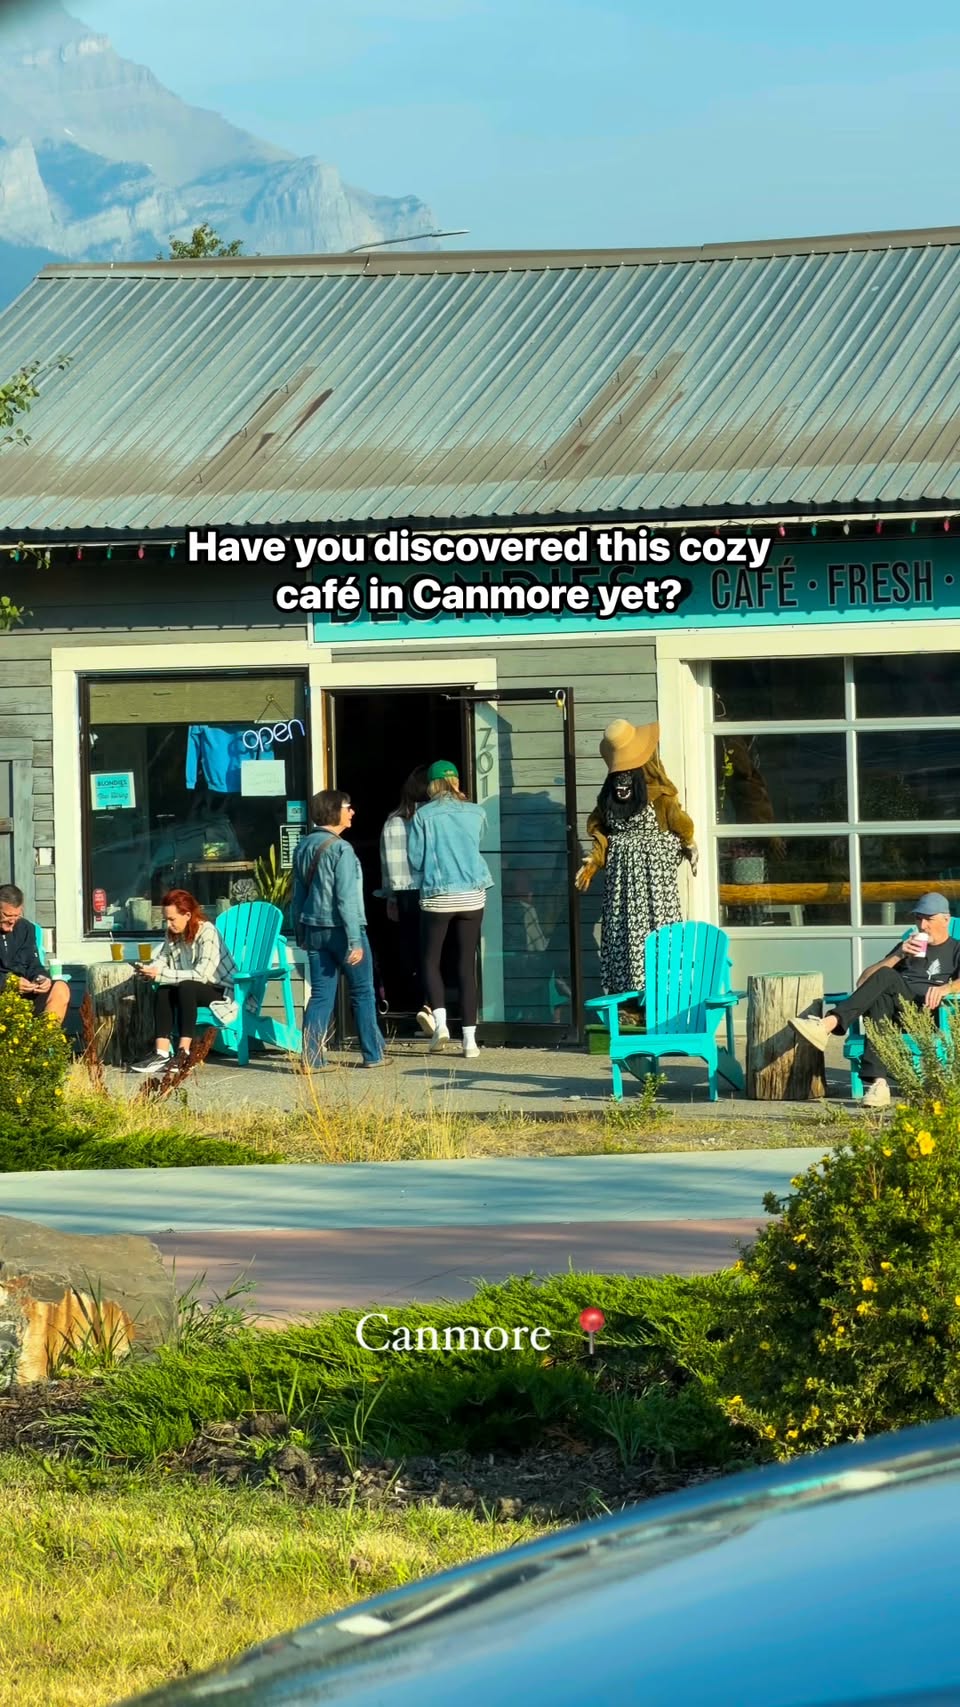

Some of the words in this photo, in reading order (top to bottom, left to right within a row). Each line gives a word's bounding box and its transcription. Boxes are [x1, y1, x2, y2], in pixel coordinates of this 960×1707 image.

[329, 564, 636, 625] ONDIES
[711, 557, 798, 610] CAFÉ
[827, 560, 933, 606] FRESH
[242, 718, 305, 752] open
